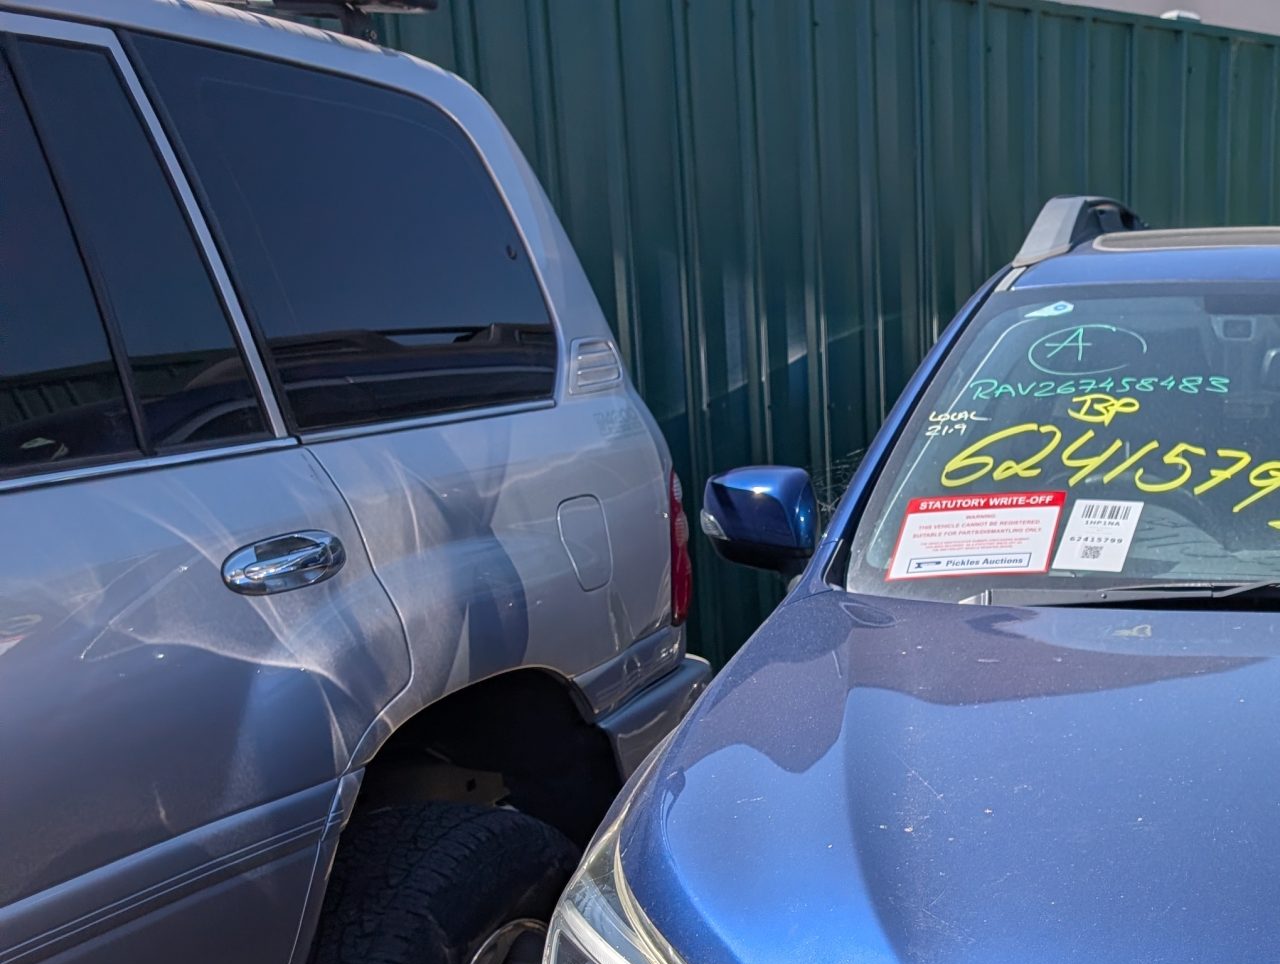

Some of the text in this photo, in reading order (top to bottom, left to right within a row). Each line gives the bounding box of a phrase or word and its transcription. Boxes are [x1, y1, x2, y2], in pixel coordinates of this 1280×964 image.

[1045, 327, 1092, 361] A
[928, 410, 992, 422] LOCAL
[919, 495, 1054, 511] STATUTORY WRITE-OFF
[946, 557, 1023, 567] Pickles Auctions
